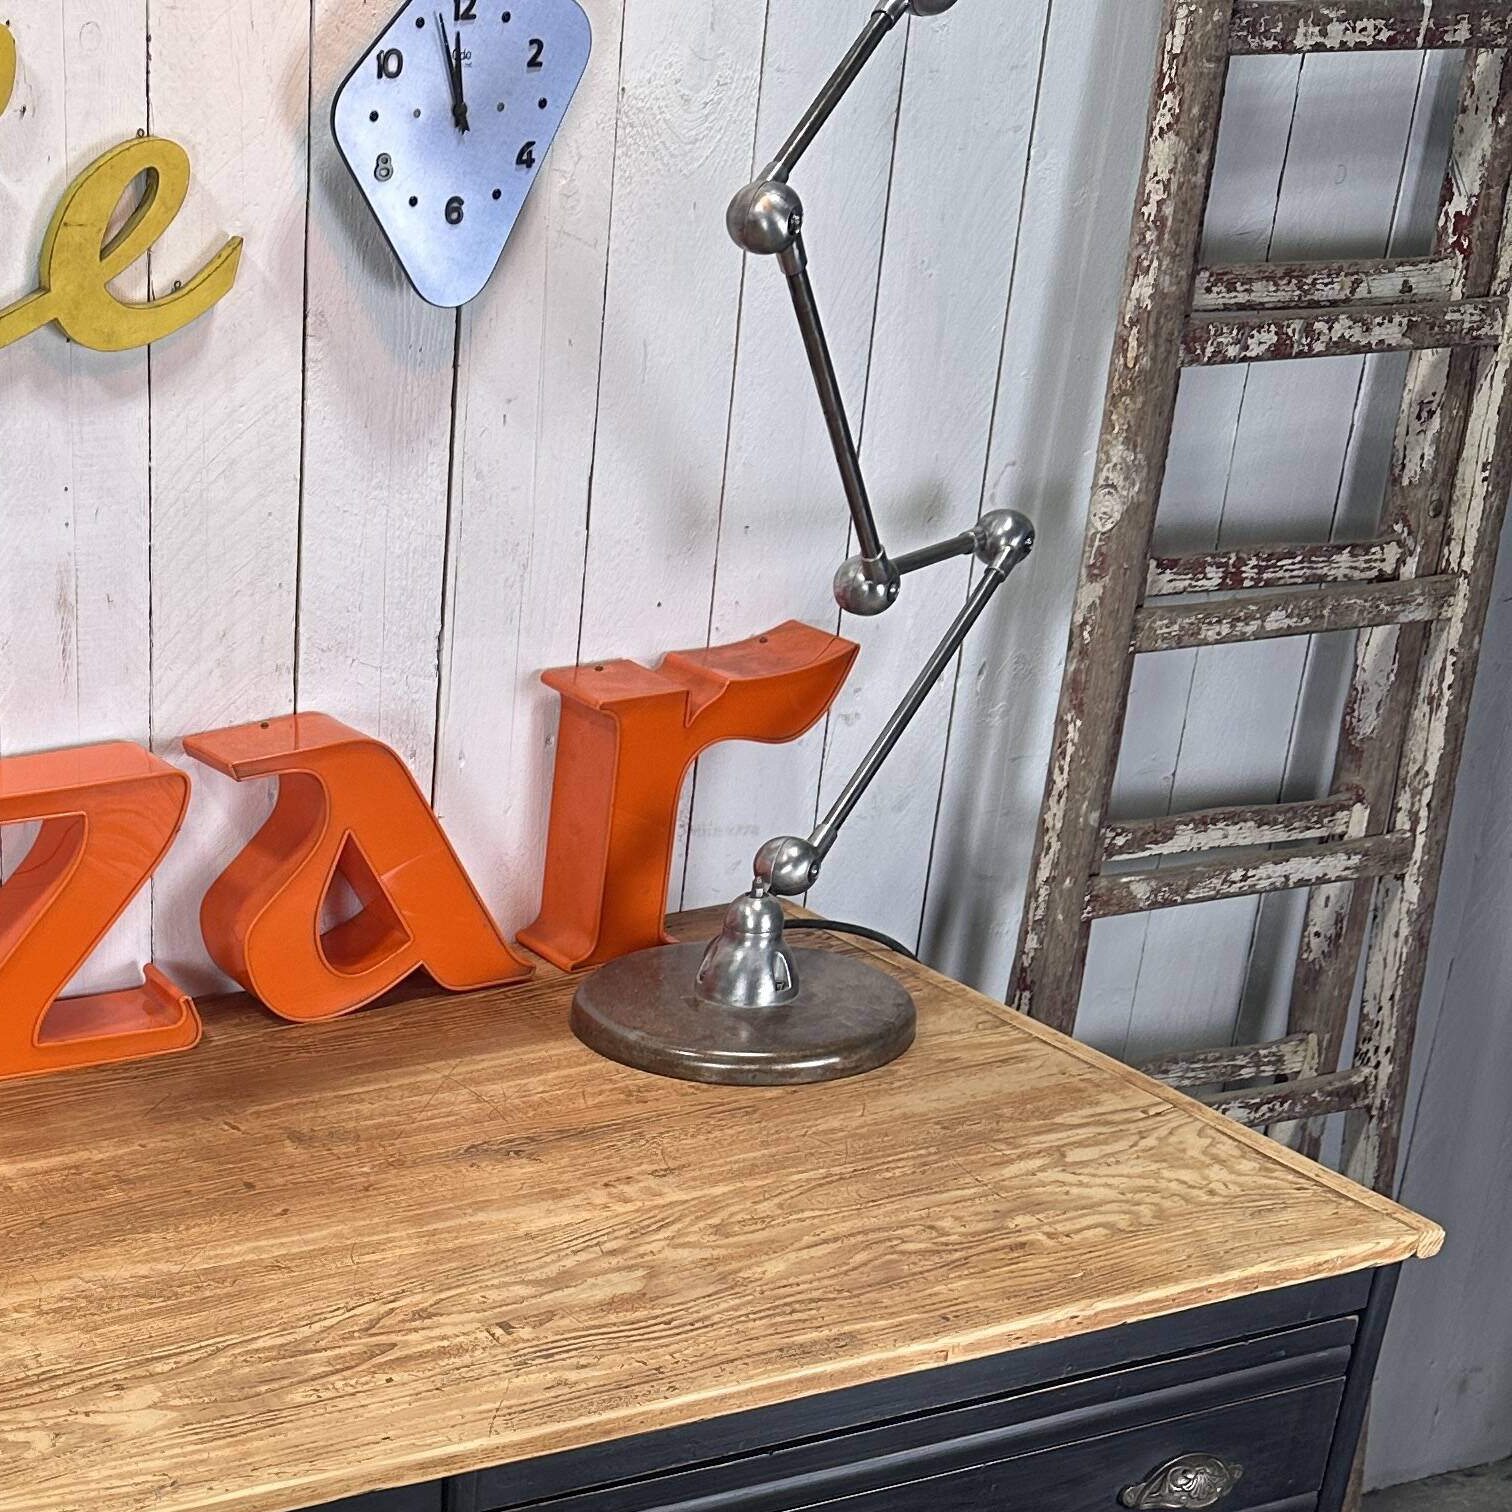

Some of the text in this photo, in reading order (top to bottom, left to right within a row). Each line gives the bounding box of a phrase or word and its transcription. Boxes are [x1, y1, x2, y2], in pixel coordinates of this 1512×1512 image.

[376, 48, 404, 80] 10
[527, 38, 545, 68] 2
[373, 152, 394, 182] 8
[516, 141, 536, 169] 4
[445, 196, 465, 225] 6
